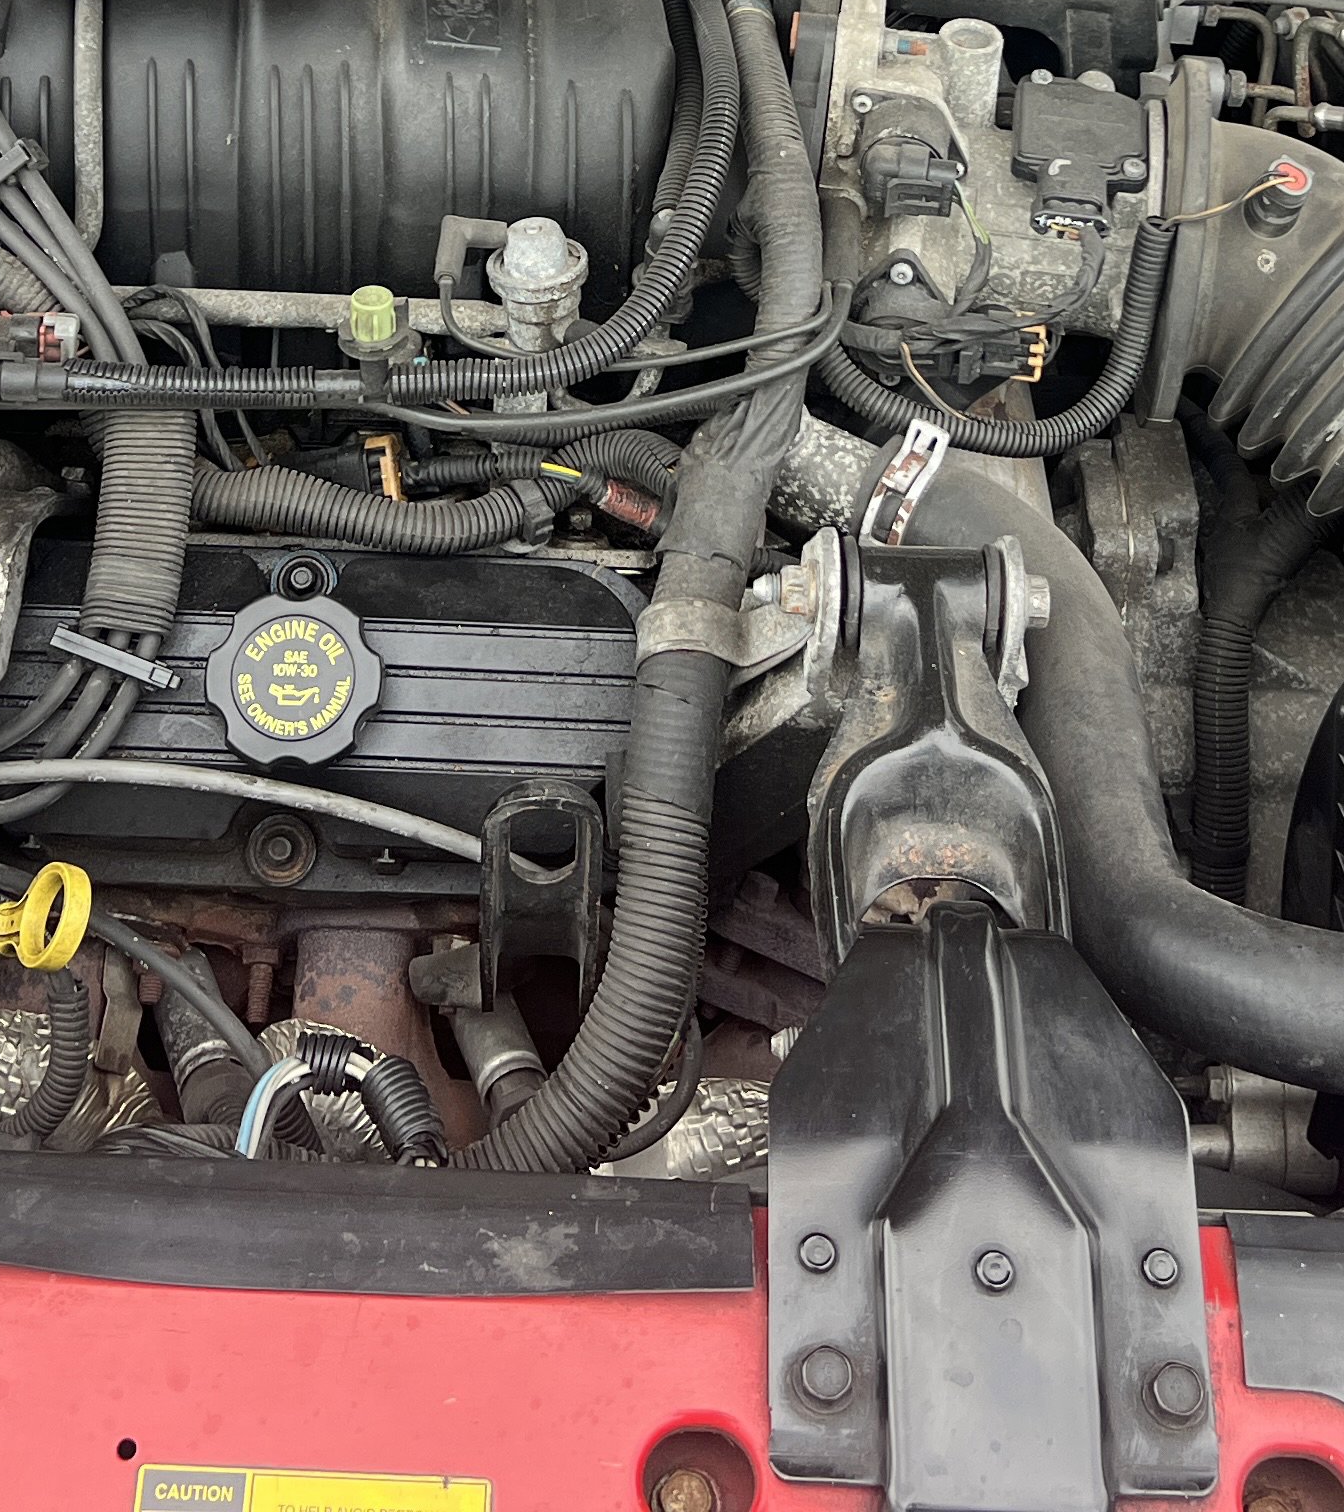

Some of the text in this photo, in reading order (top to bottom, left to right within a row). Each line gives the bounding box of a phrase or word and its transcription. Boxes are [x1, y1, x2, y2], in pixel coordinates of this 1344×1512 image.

[245, 619, 345, 666] ENGINE OIL
[284, 650, 309, 663] SAE
[272, 663, 318, 677] 10W-30
[237, 673, 351, 736] SEE OWNER'S MANUAL
[154, 1483, 234, 1503] CAUTION
